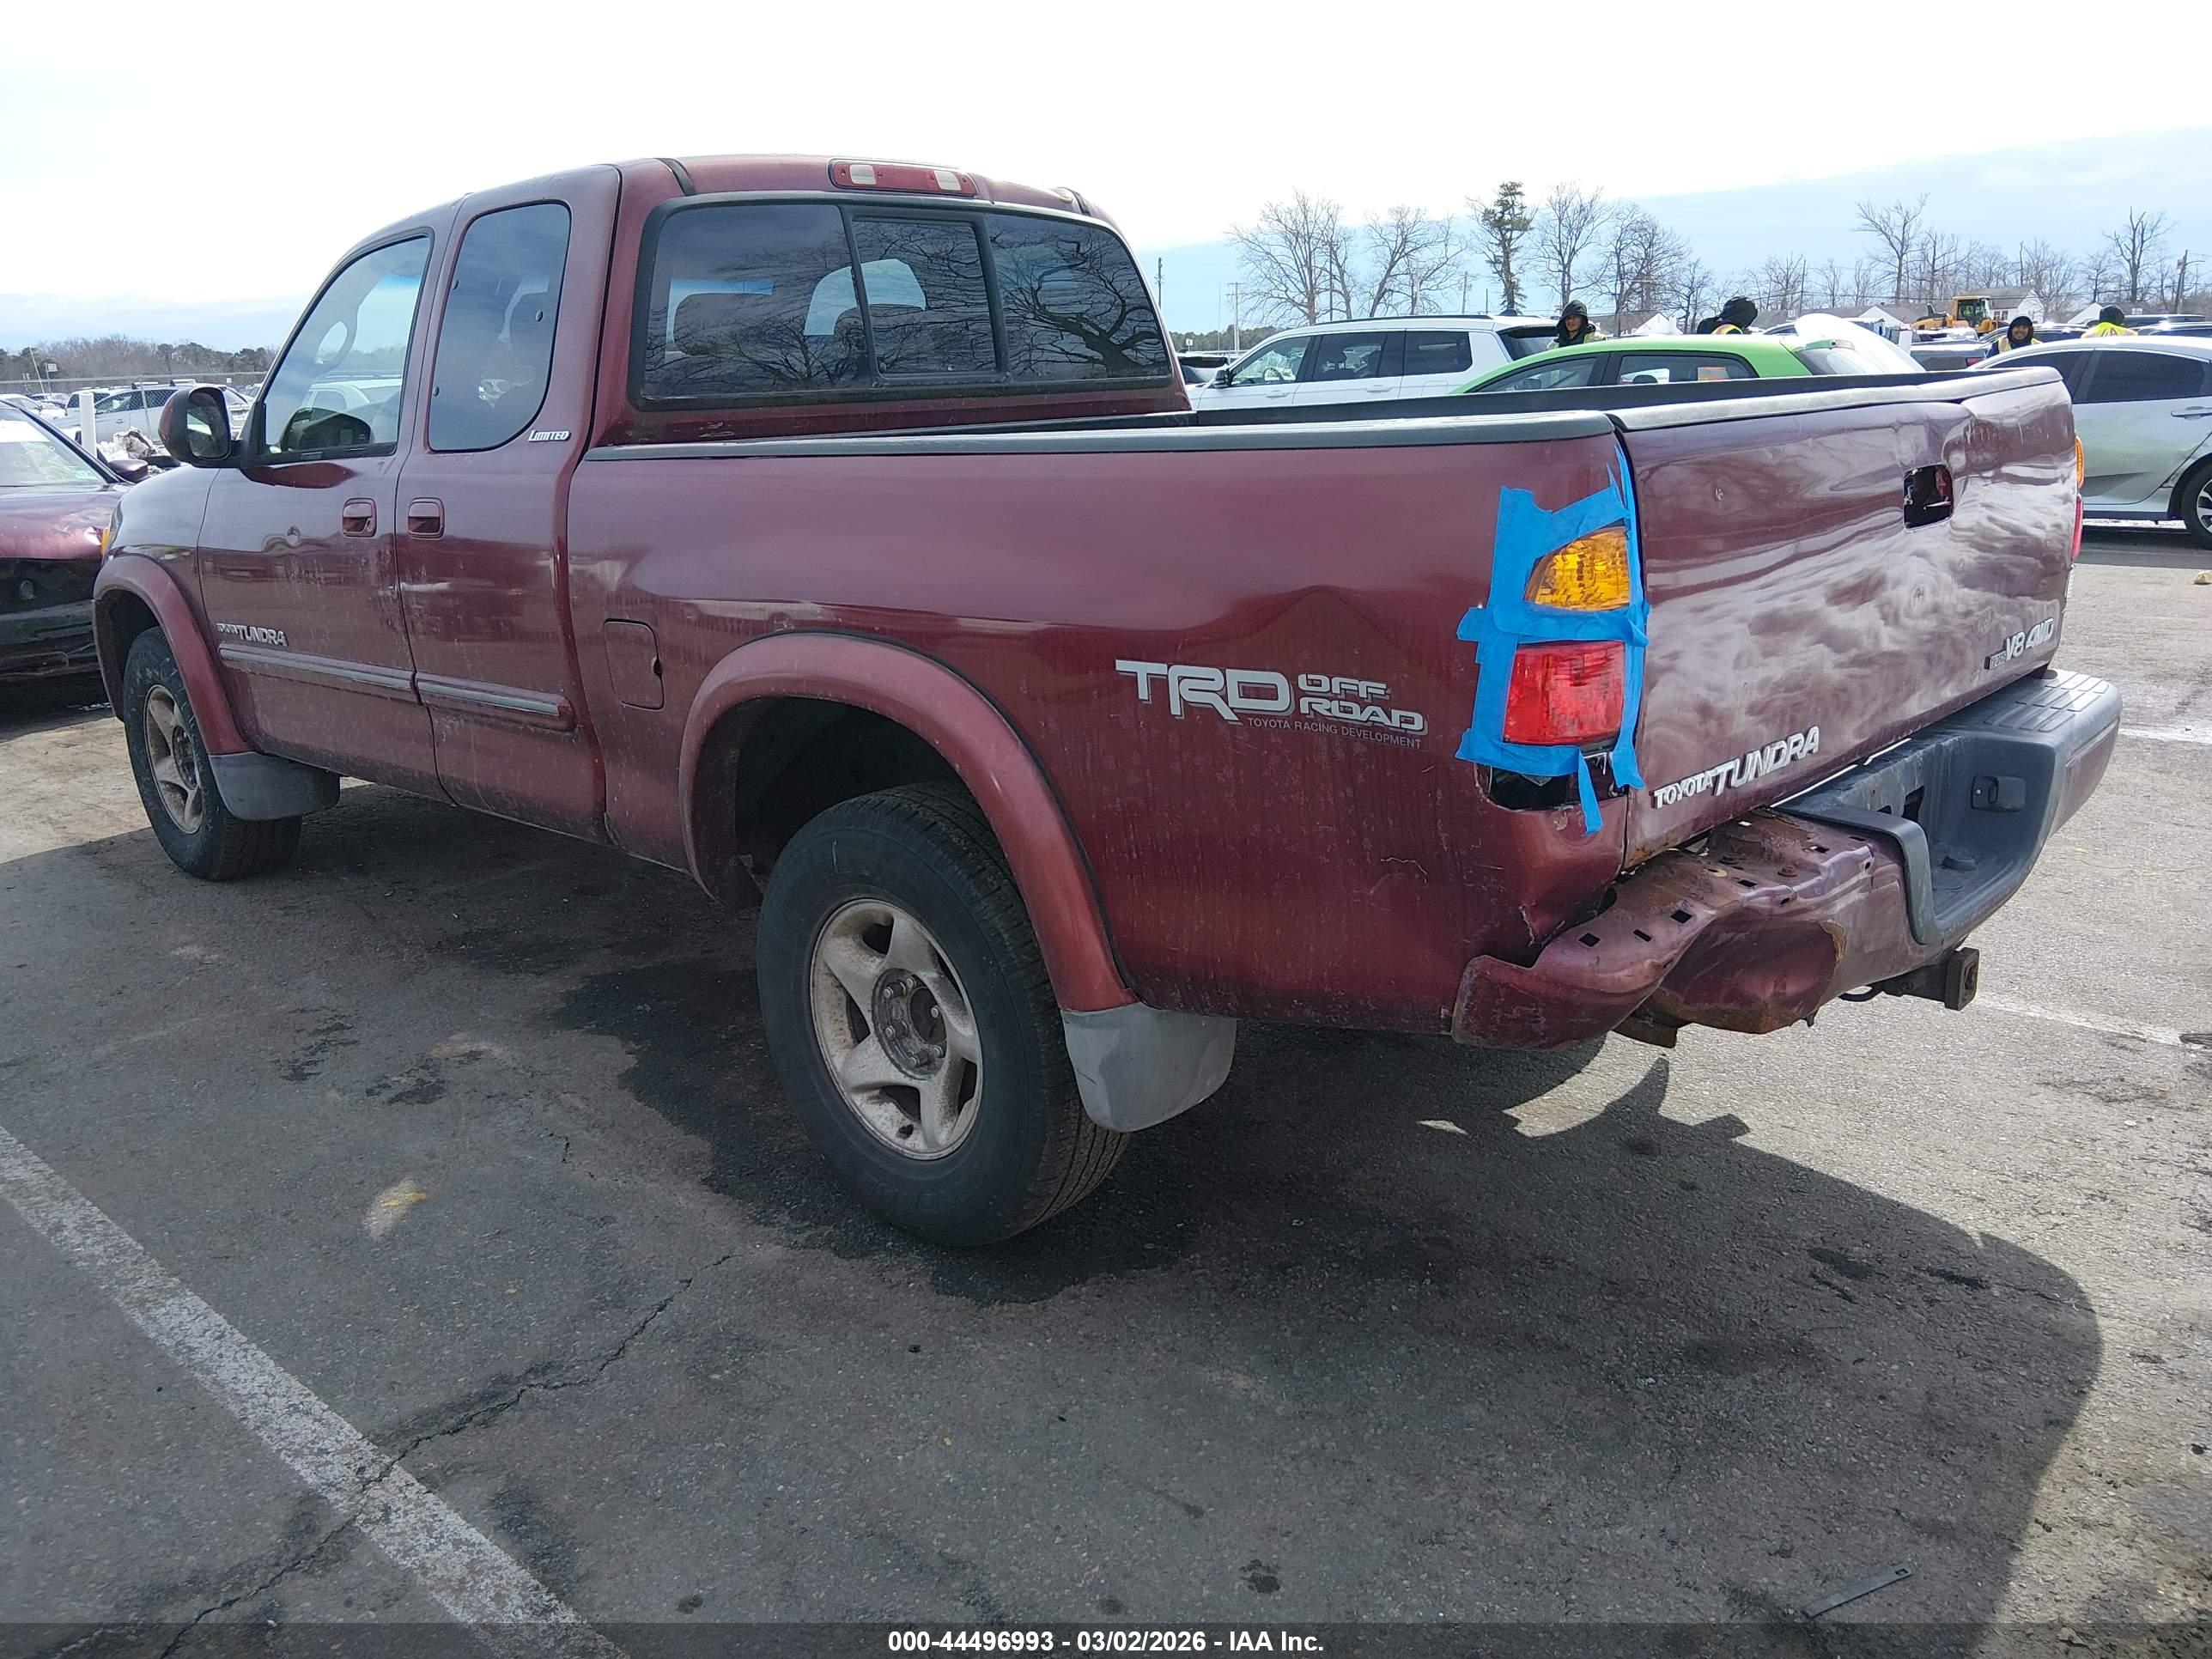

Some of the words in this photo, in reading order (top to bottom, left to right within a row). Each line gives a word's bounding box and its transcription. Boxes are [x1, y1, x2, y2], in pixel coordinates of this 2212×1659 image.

[236, 625, 288, 647] TUNDRA
[2006, 631, 2026, 660] V8
[2026, 617, 2054, 649] 4WD
[1115, 659, 1292, 722] TRD
[1297, 673, 1389, 699] OFF
[1299, 696, 1425, 732] ROAD
[1248, 717, 1291, 730] TOYOTA
[1294, 720, 1339, 734] RACING
[1341, 726, 1422, 750] DEVELOPMENT
[1653, 772, 1714, 809] TOYOTA
[1710, 726, 1820, 797] TUNDRA
